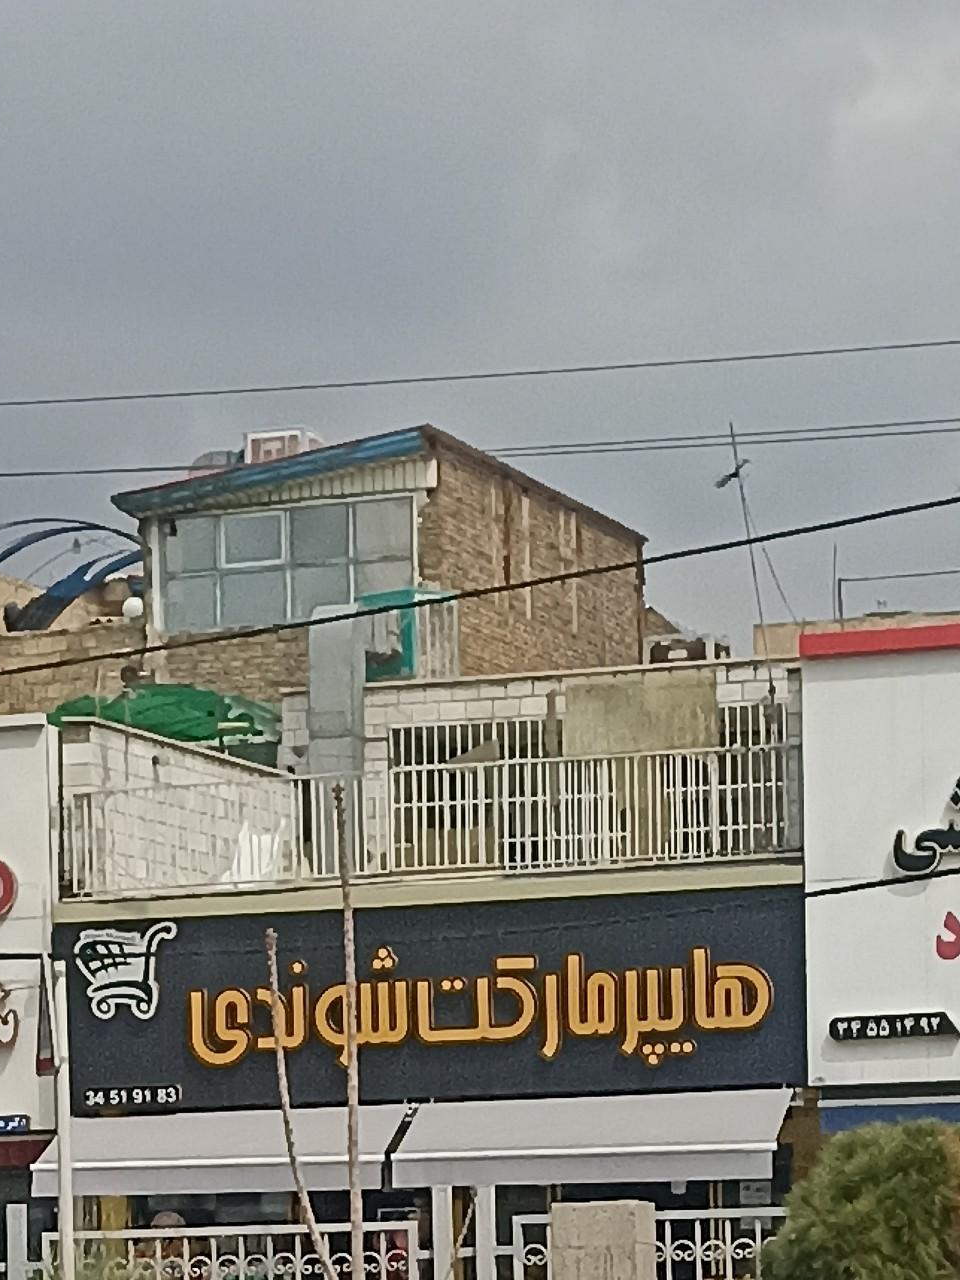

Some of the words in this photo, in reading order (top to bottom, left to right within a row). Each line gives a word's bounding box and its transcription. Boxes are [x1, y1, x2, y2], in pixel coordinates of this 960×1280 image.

[866, 1018, 890, 1037] ۵۵
[86, 1090, 105, 1106] 34
[109, 1089, 127, 1105] 51
[132, 1088, 151, 1104] 91
[156, 1086, 177, 1104] 83
